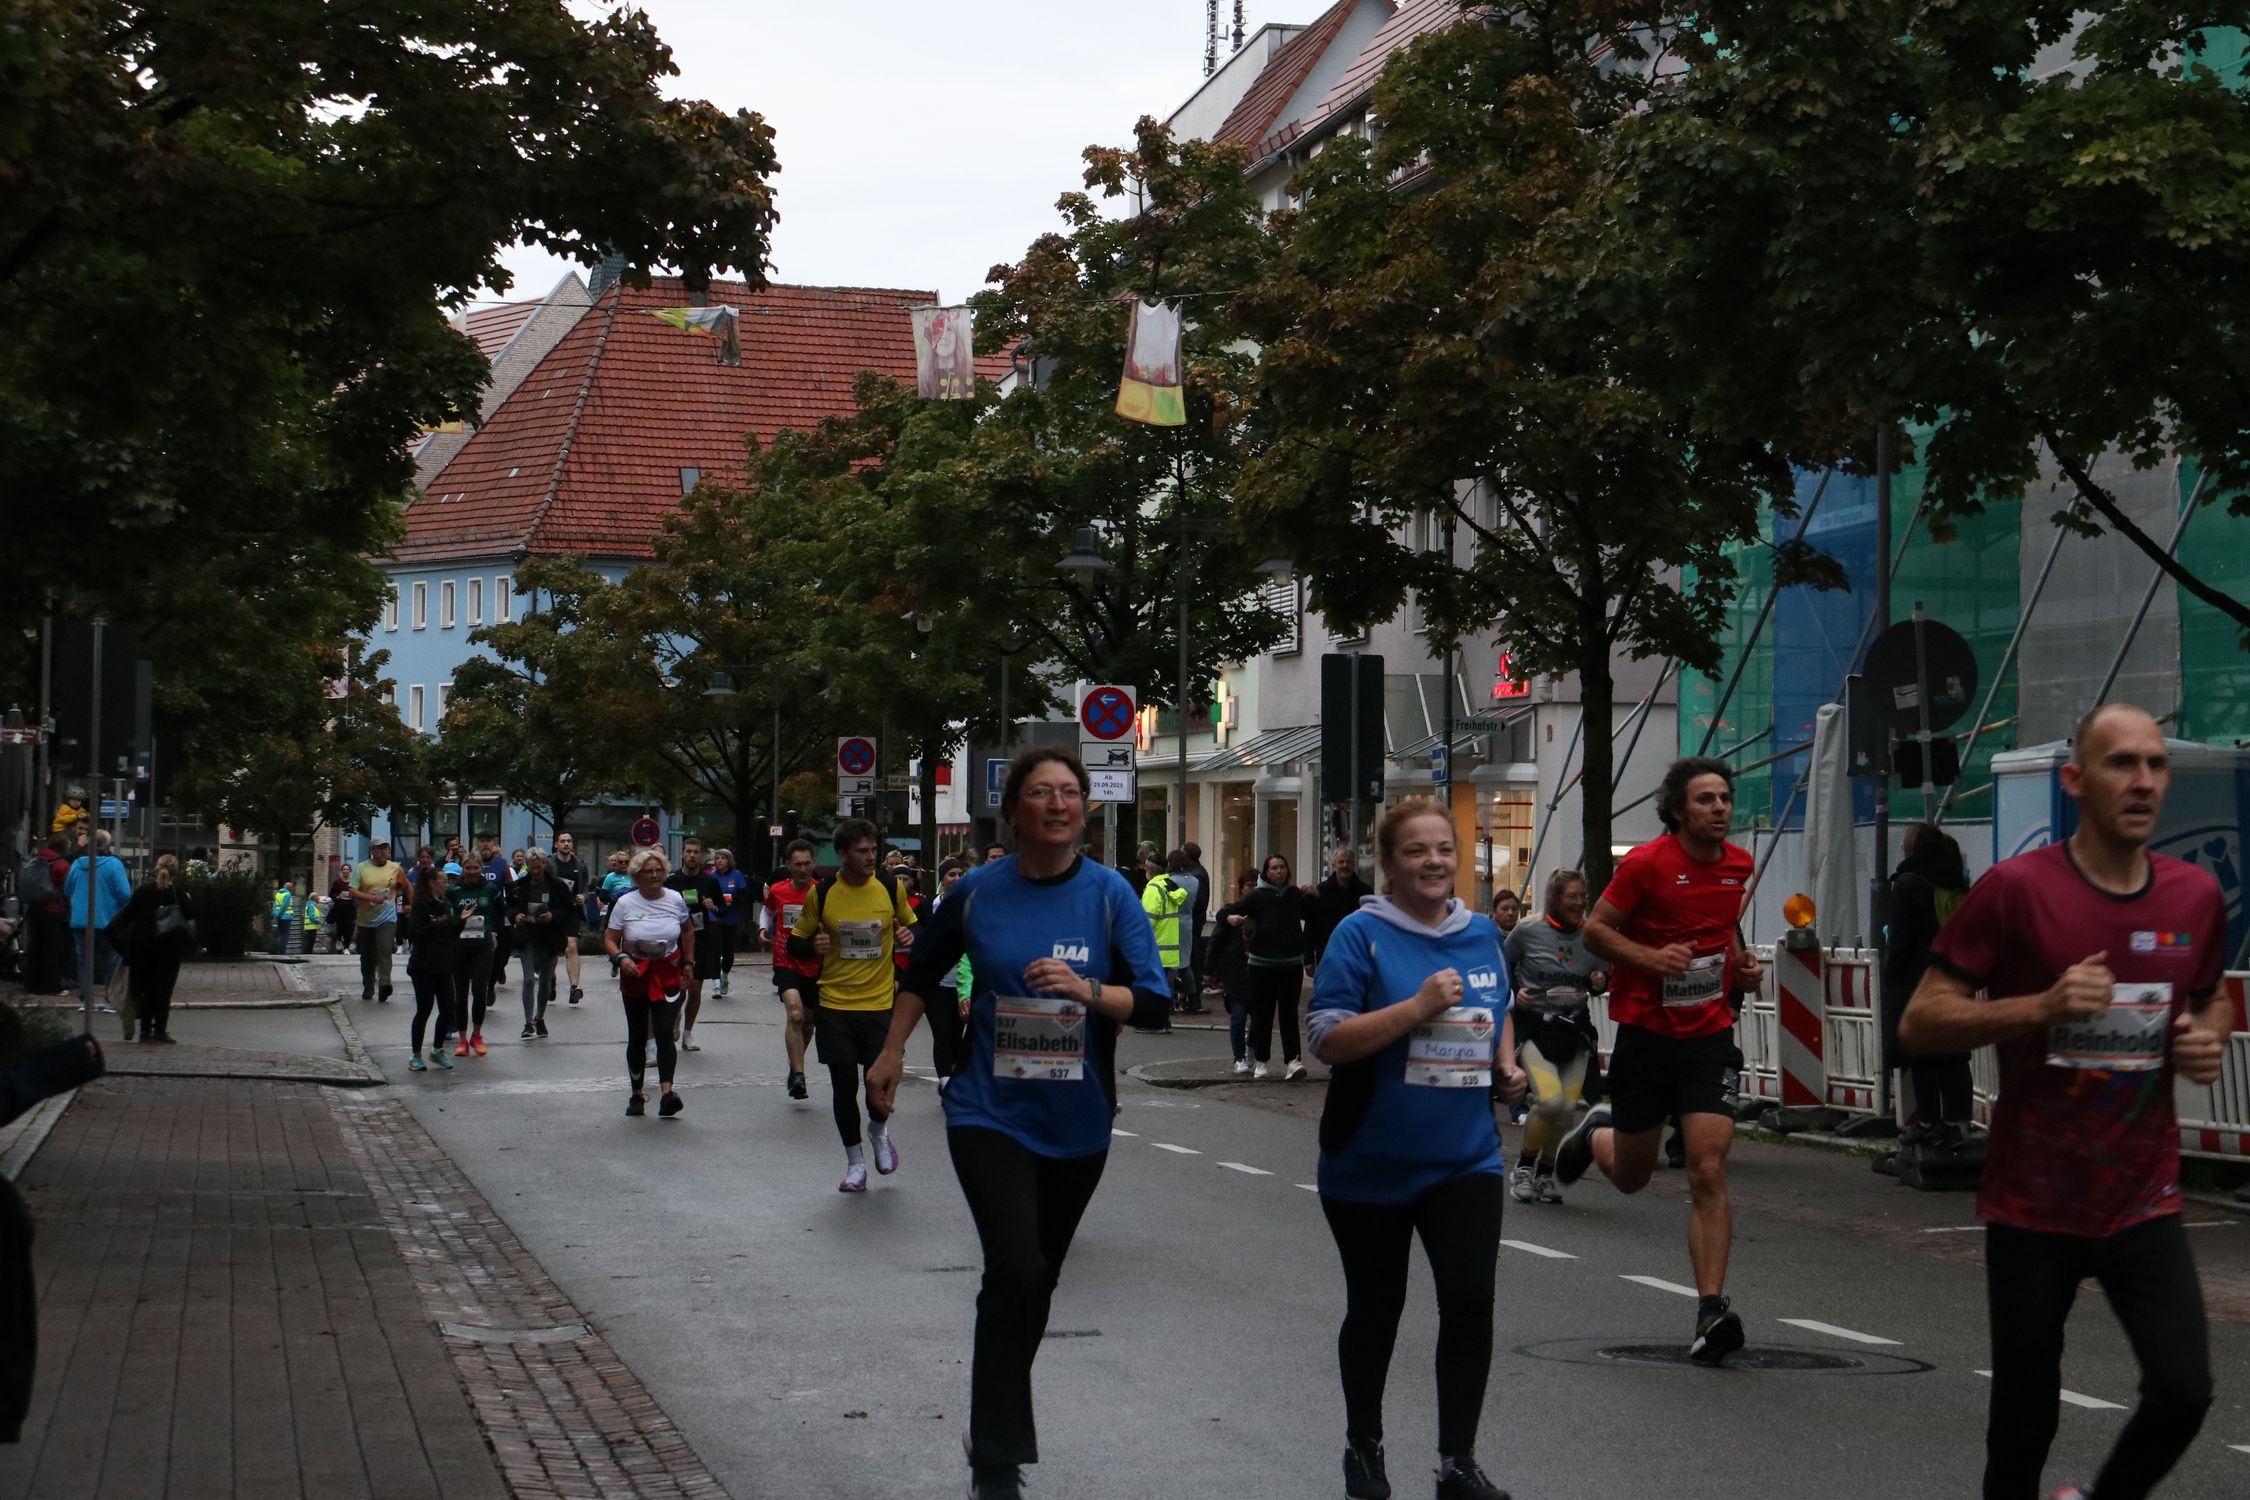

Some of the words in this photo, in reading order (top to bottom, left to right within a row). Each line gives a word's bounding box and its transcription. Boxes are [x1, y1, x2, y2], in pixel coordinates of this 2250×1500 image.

[1455, 719, 1499, 731] Freihofstr.
[458, 898, 479, 907] AOK
[851, 937, 871, 946] Ivan
[1052, 943, 1090, 963] DAA
[1665, 979, 1721, 997] Matthias
[997, 1017, 1017, 1028] 537
[996, 1031, 1079, 1052] Elisabeth
[2054, 1025, 2163, 1052] Reinhold
[1049, 1068, 1070, 1079] 537
